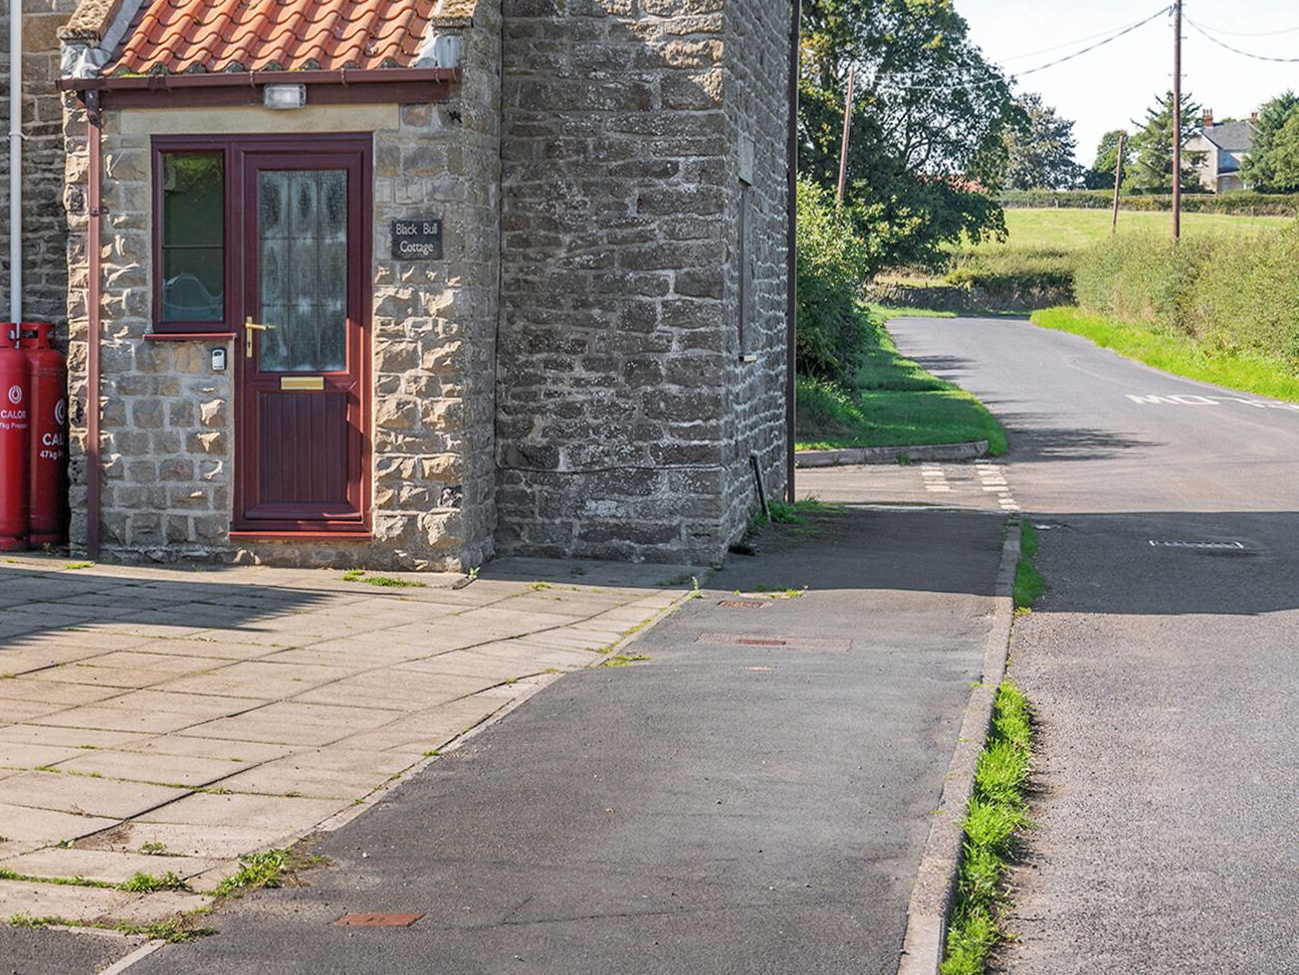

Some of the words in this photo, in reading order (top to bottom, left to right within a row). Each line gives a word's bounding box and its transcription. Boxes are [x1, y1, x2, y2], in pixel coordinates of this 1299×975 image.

[395, 222, 417, 235] Black
[422, 222, 438, 235] Bull
[399, 240, 434, 256] Cottage
[0, 409, 27, 419] CALOR
[39, 450, 57, 461] 47kg
